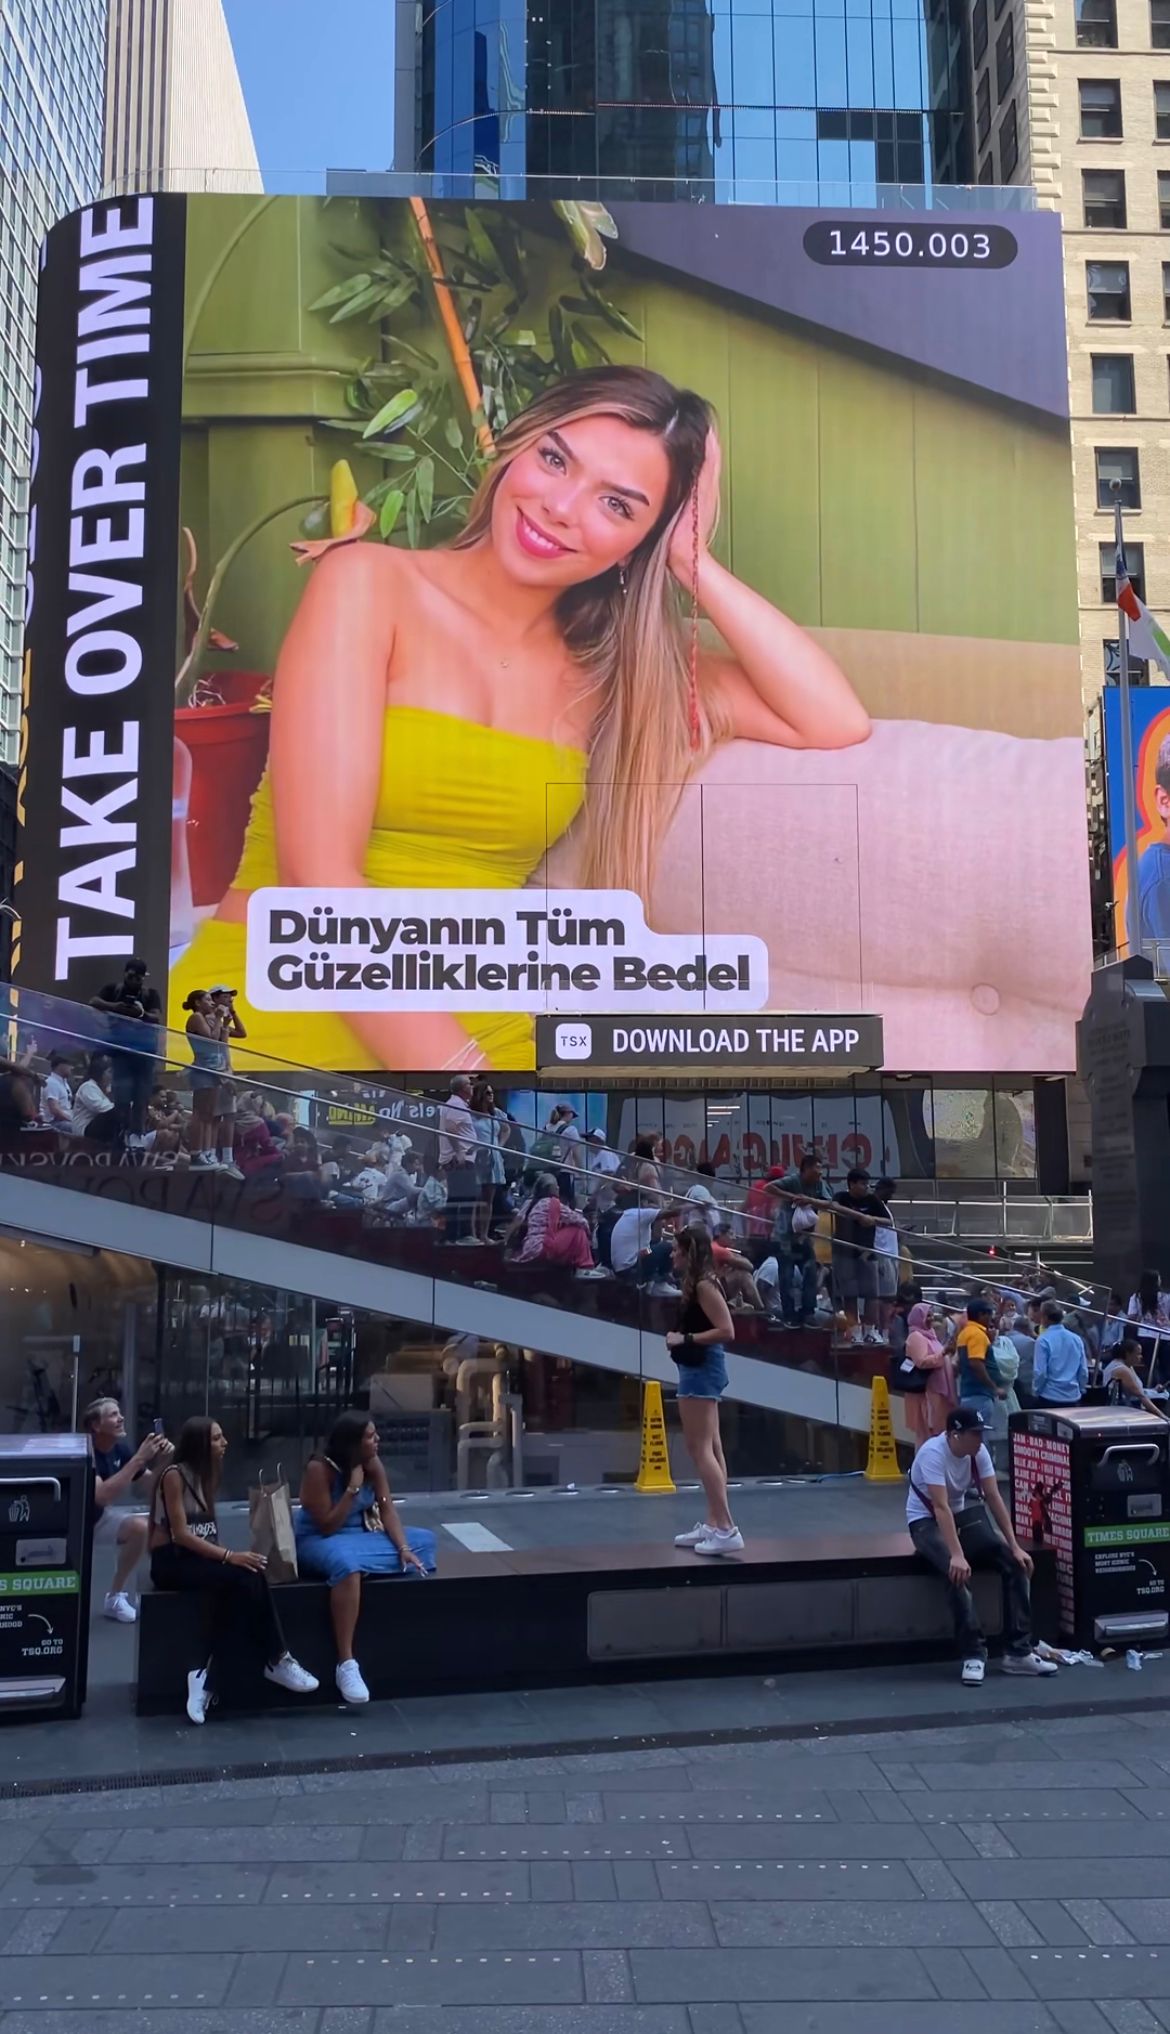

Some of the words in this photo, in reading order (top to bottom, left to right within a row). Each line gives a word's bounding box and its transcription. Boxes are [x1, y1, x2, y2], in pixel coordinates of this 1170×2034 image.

[830, 229, 991, 259] 1450.003
[74, 196, 154, 429] TIME
[64, 443, 147, 697] OVER
[55, 721, 140, 981] TAKE
[269, 906, 506, 954] Dünyanın
[516, 907, 626, 946] Tüm
[267, 949, 601, 991] Güzelliklerine
[613, 954, 750, 991] Bedel
[560, 1035, 588, 1047] TSX
[612, 1028, 750, 1053] DOWNLOAD
[756, 1028, 806, 1053] THE
[811, 1028, 860, 1053] APP
[1013, 1432, 1026, 1444] JAM
[1029, 1435, 1043, 1448] BAD
[1087, 1530, 1124, 1543] TIMES
[1126, 1527, 1169, 1541] SQUARE
[12, 1576, 76, 1591] SQUARE
